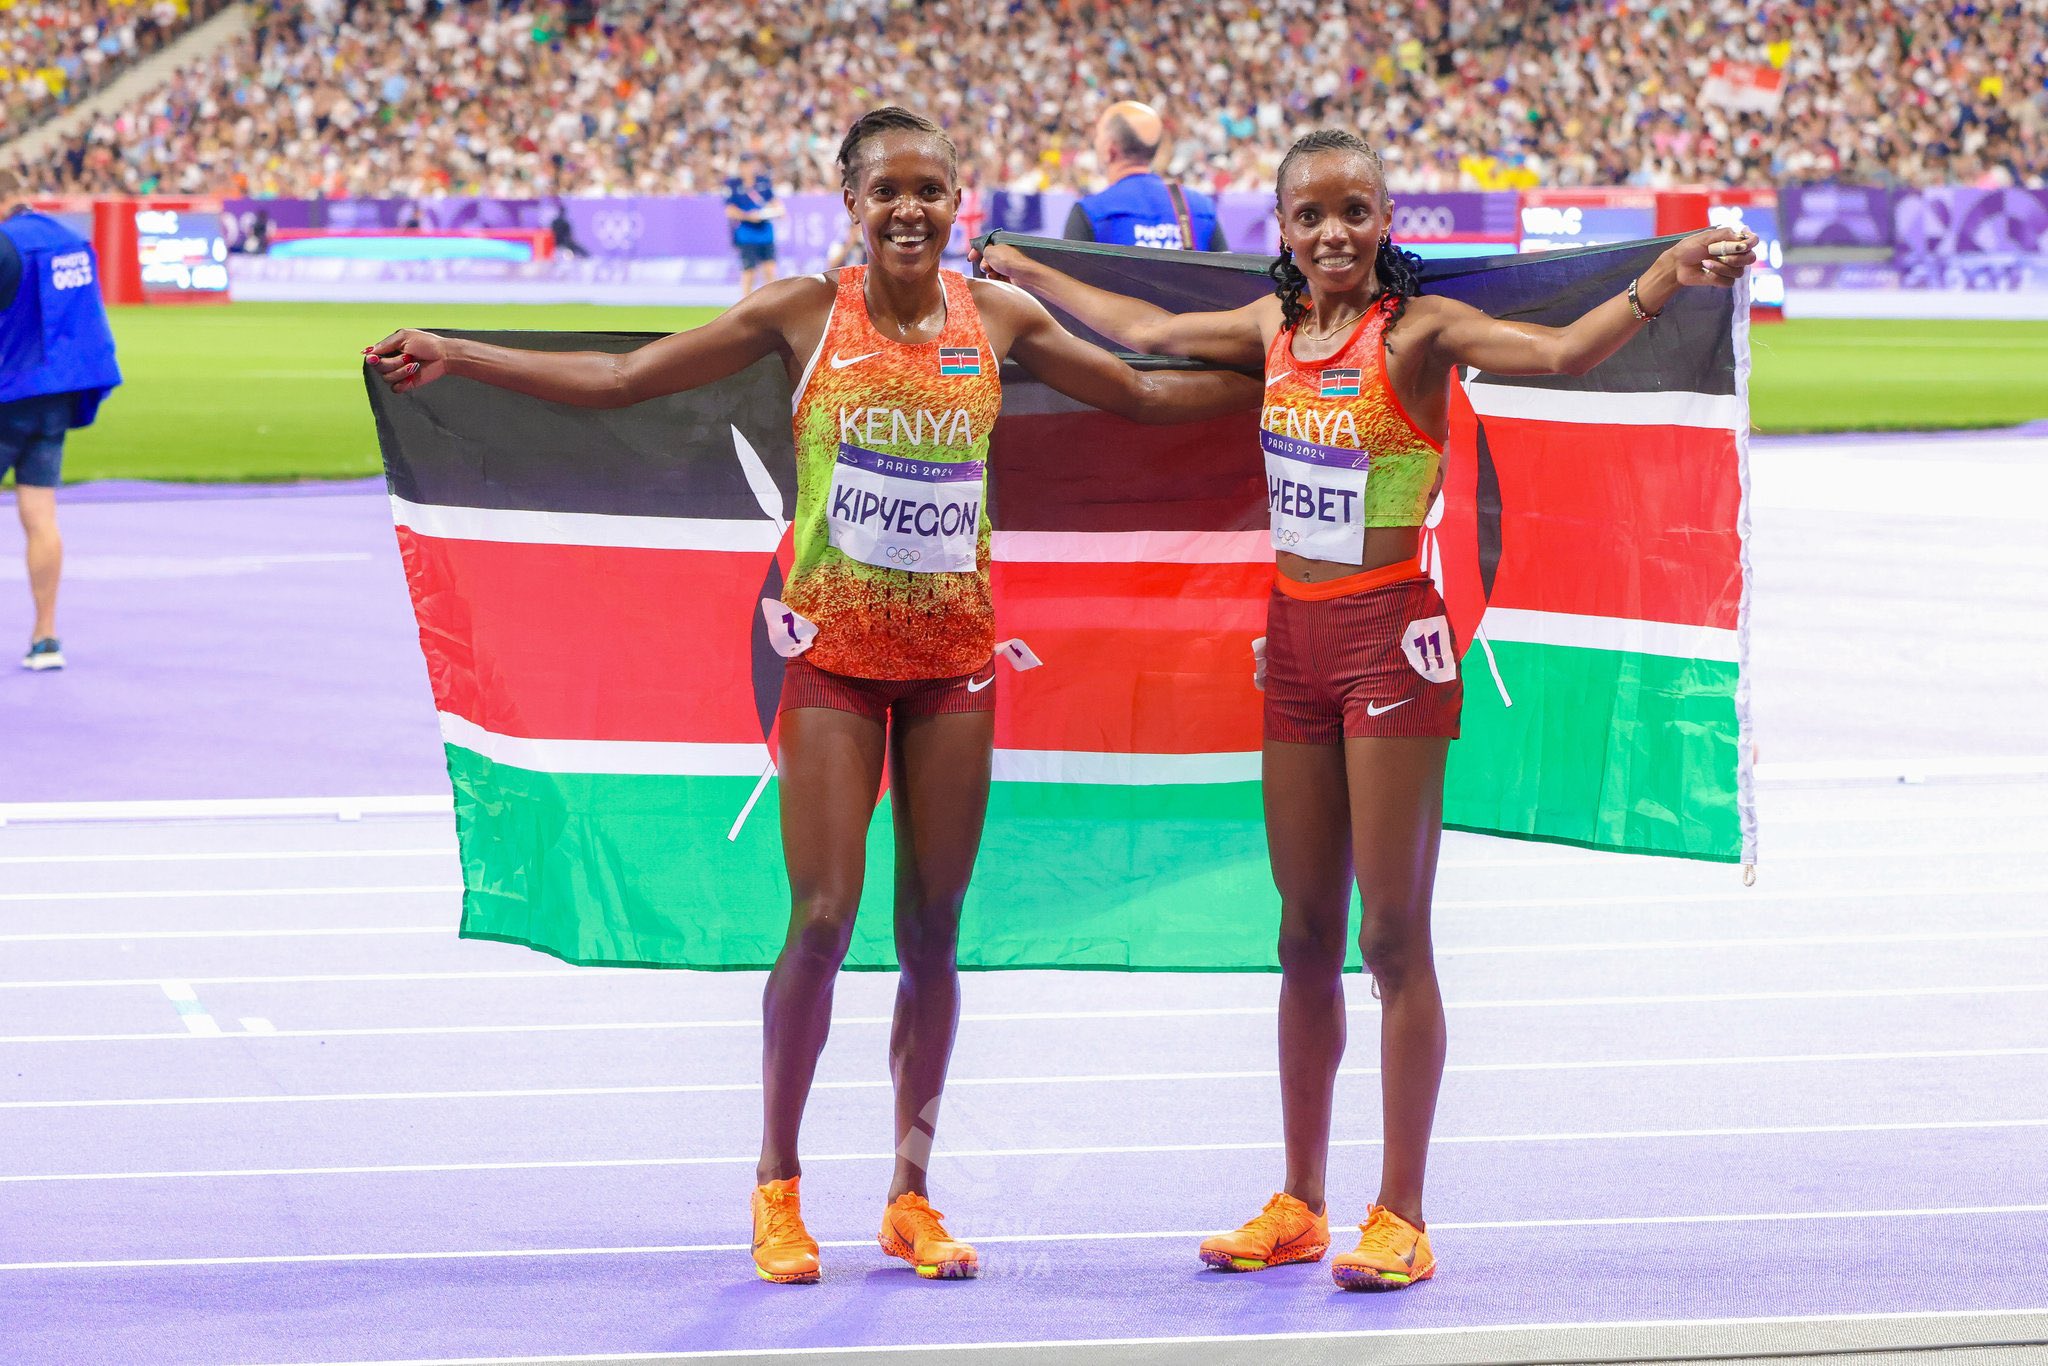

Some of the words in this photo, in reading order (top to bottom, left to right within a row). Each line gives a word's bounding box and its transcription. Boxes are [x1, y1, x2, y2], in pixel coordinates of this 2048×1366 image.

[839, 406, 973, 447] KENYA
[1296, 446, 1326, 460] 2024
[922, 466, 953, 477] 2024
[832, 484, 978, 537] KIPYEGON
[782, 612, 801, 644] 1
[1413, 630, 1444, 671] 11
